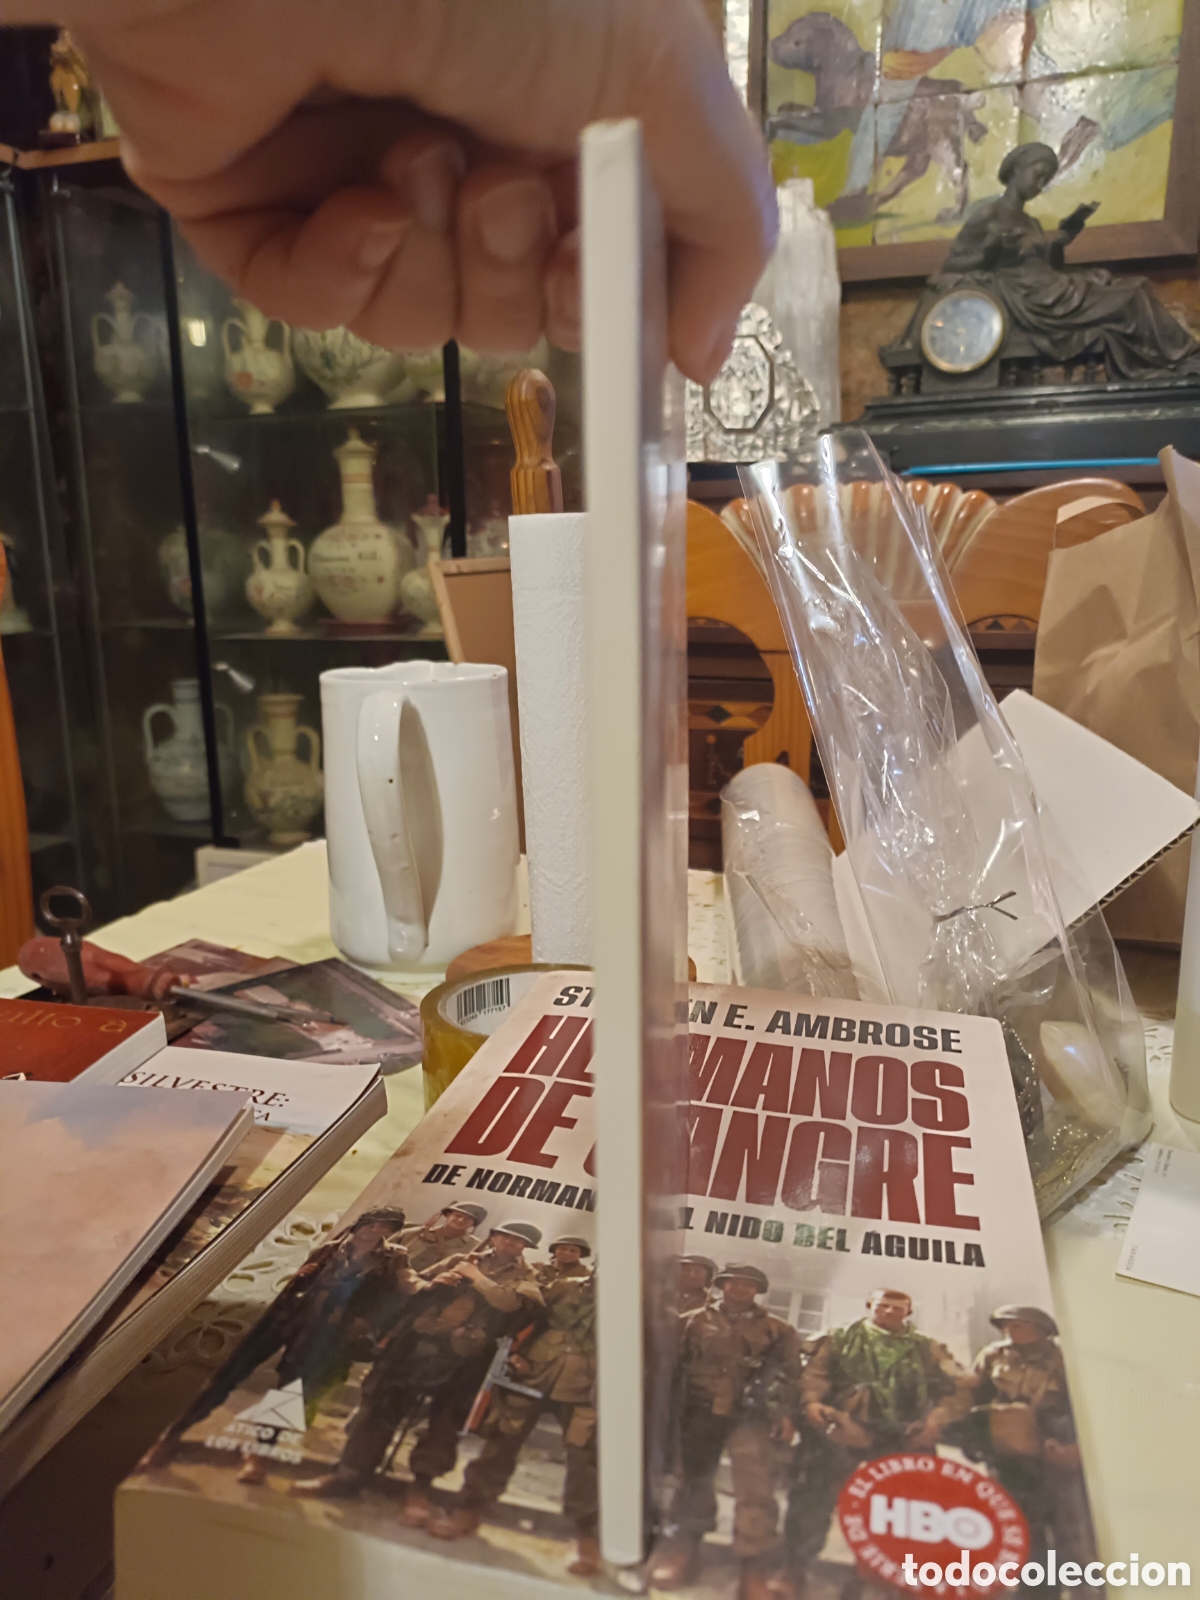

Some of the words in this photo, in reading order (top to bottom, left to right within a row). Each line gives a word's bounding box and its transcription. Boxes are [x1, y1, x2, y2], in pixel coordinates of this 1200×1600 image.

[99, 1019, 128, 1033] a
[723, 1003, 755, 1030] E.
[765, 1009, 962, 1053] AMBROSE
[502, 1014, 970, 1132] HMANOS
[443, 1075, 598, 1169] DE
[422, 1163, 467, 1186] DE
[704, 1210, 784, 1243] NIDO
[793, 1222, 850, 1253] DEL
[861, 1229, 986, 1268] ÁGUILA
[867, 1456, 936, 1482] LIBRO
[940, 1461, 974, 1486] EN
[870, 1493, 994, 1551] HBO
